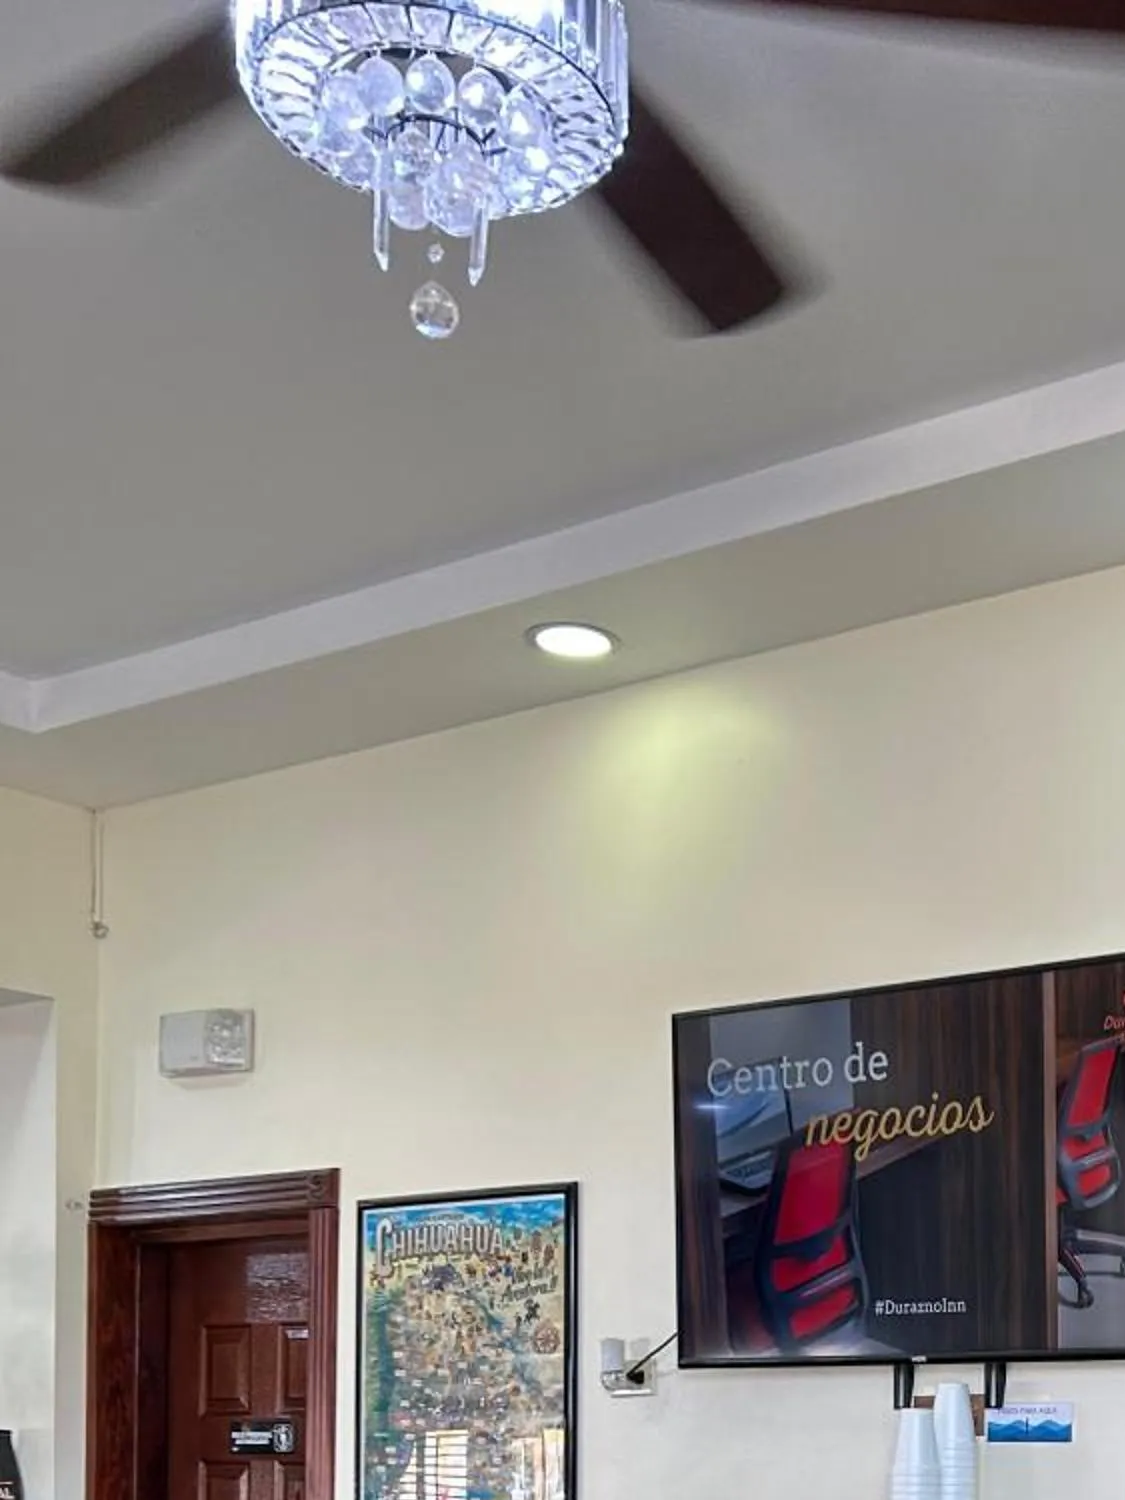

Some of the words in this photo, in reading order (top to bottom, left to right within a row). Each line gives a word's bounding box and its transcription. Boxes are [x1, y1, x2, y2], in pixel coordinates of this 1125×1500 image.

[707, 1055, 833, 1097] Centro
[844, 1041, 889, 1082] de
[805, 1091, 995, 1162] negocios
[376, 1218, 503, 1277] CHIHUAHUA
[875, 1298, 967, 1316] #DuraznoInn
